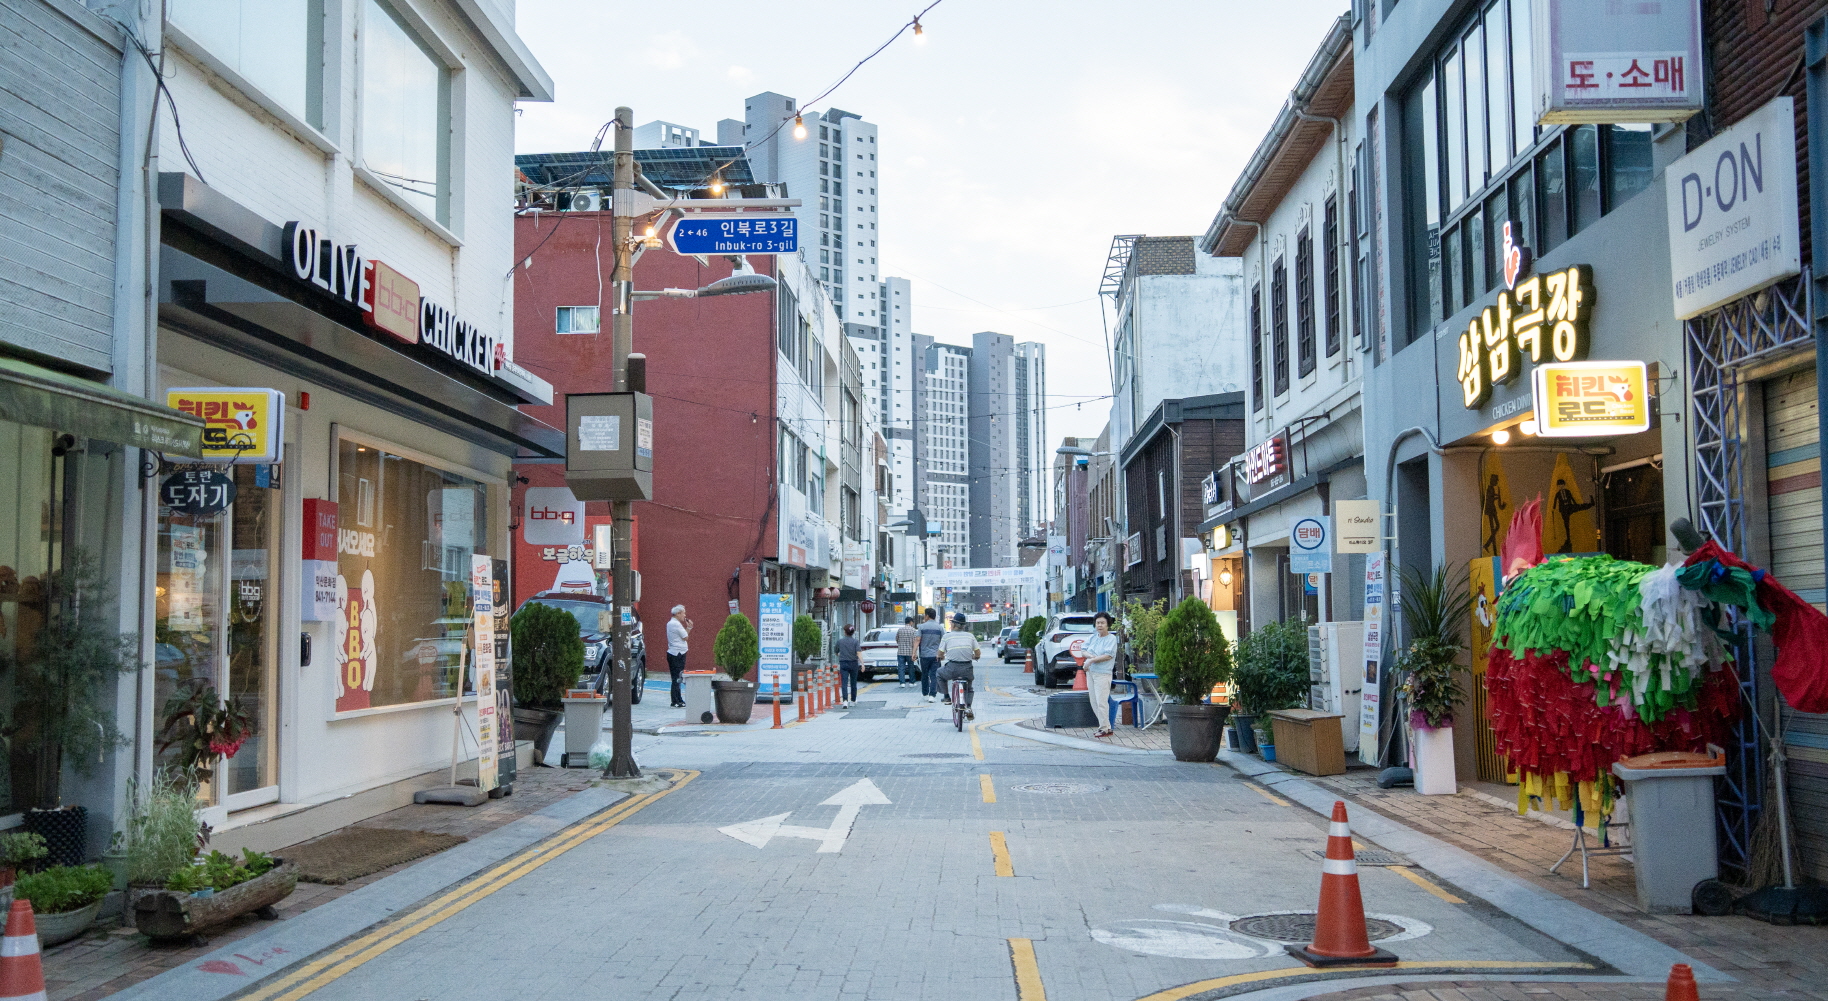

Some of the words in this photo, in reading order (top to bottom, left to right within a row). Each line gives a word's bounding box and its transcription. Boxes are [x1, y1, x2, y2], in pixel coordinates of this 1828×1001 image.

[679, 229, 685, 237] 2
[696, 229, 708, 237] 46
[720, 220, 794, 238] 인북로3길
[1697, 230, 1724, 252] JEWELRY
[1725, 215, 1751, 238] SYSTEM
[715, 241, 763, 251] Inbuk-ro
[766, 240, 794, 252] 3-gil
[287, 222, 373, 313] OLIVE
[420, 296, 496, 378] CHICKEN
[1456, 266, 1584, 409] 삼남극장
[1555, 374, 1606, 398] 치킨
[1492, 401, 1516, 420] CHICKEN
[1558, 401, 1606, 421] 로드
[184, 470, 213, 484] 토란
[167, 483, 228, 508] 도자기
[318, 511, 336, 530] TAKE
[319, 532, 333, 548] OUT
[1298, 527, 1321, 539] 담배
